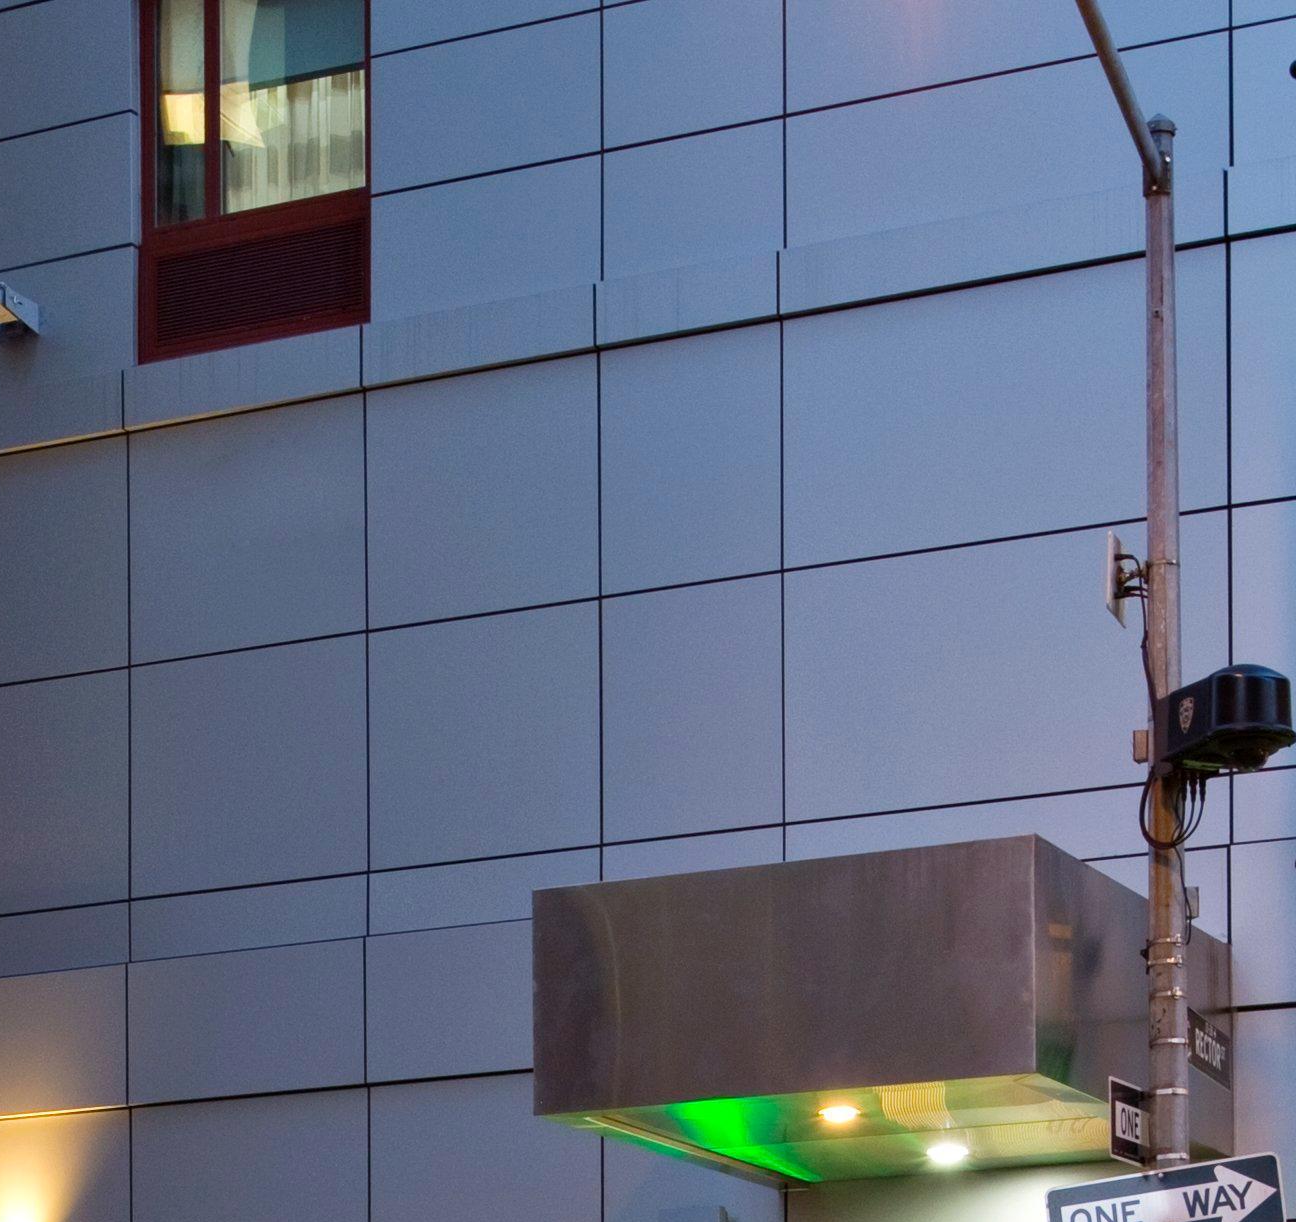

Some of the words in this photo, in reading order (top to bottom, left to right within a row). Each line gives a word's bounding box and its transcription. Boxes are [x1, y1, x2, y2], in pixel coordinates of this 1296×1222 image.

[1195, 1028, 1221, 1071] RECTOR
[1120, 1107, 1140, 1139] ONE
[1183, 1181, 1253, 1218] WAY
